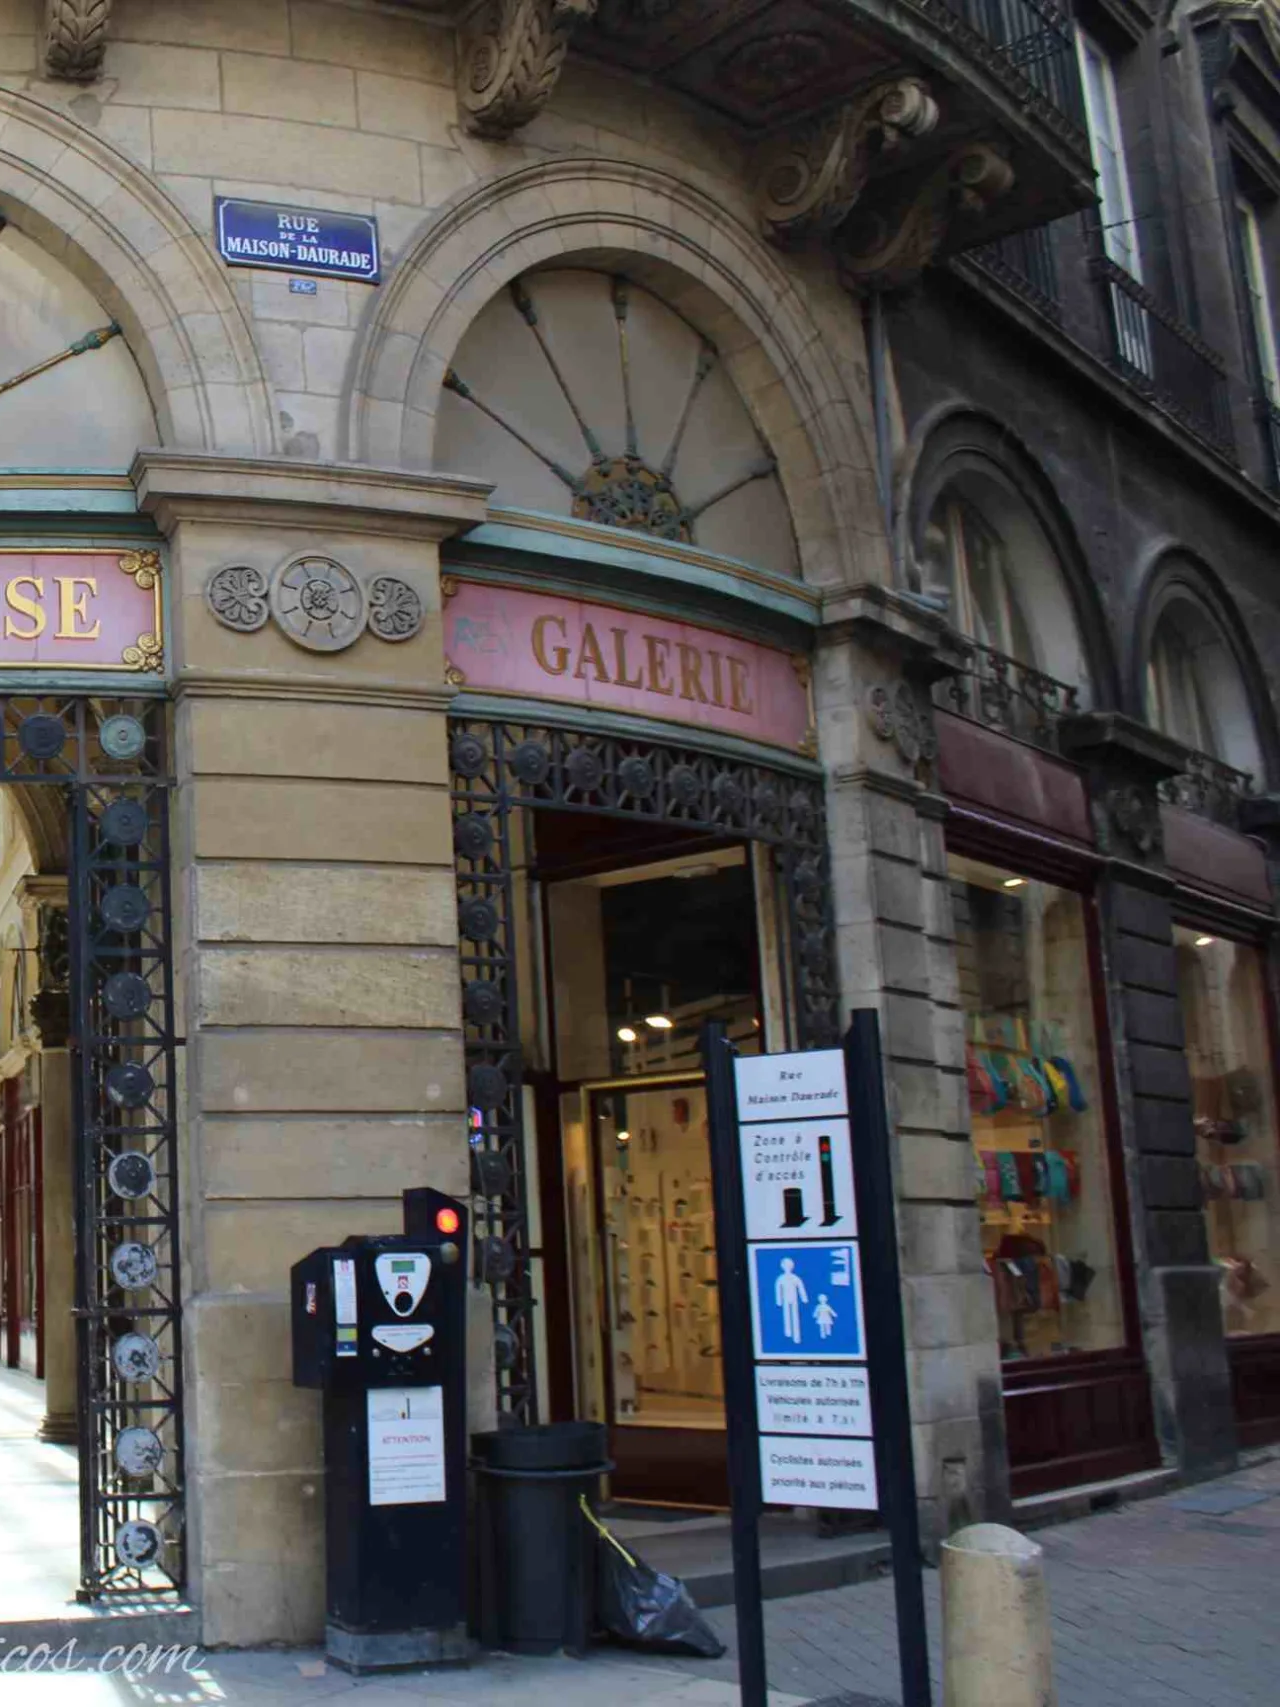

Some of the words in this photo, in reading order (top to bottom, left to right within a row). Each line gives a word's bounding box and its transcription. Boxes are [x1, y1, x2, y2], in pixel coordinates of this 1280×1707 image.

[277, 213, 319, 233] RUE
[279, 232, 296, 241] DE
[302, 234, 318, 244] LA
[227, 236, 371, 270] MAISON-DAURADE
[530, 614, 754, 715] GALERIE
[779, 1070, 803, 1081] Rue
[753, 1135, 786, 1147] Zone
[754, 1150, 812, 1164] Contrôle
